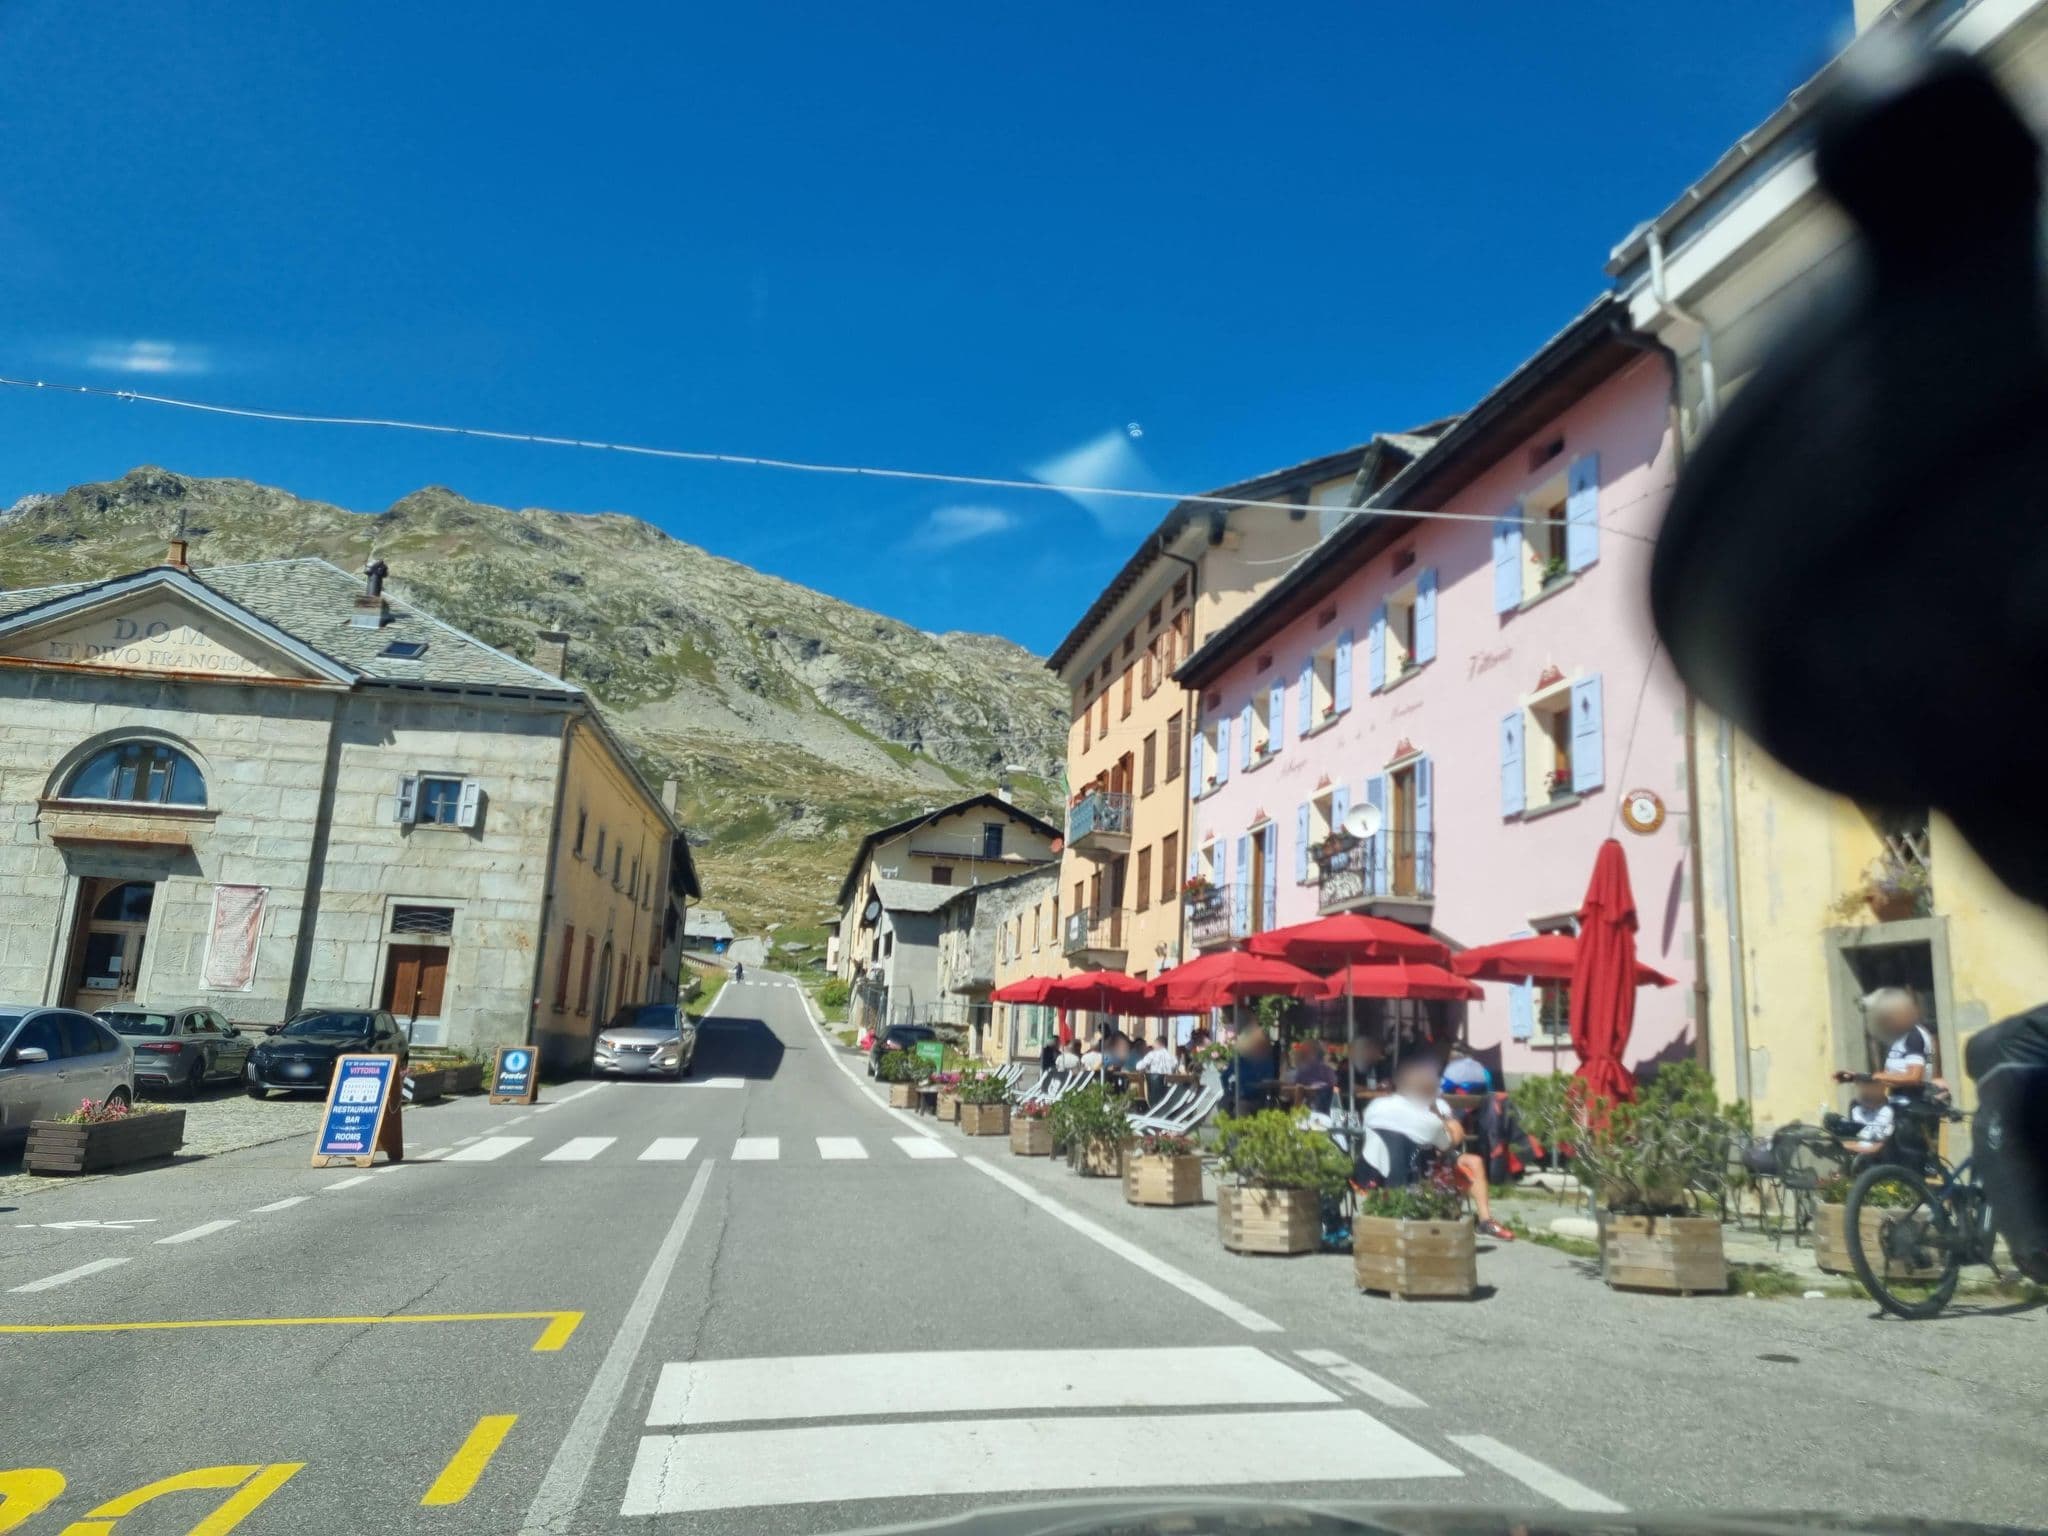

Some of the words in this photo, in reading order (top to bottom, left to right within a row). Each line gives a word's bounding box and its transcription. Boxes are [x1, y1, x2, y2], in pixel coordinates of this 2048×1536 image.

[332, 1105, 379, 1114] RESTAURANT
[344, 1115, 360, 1124] BAR
[334, 1132, 362, 1141] ROOMS
